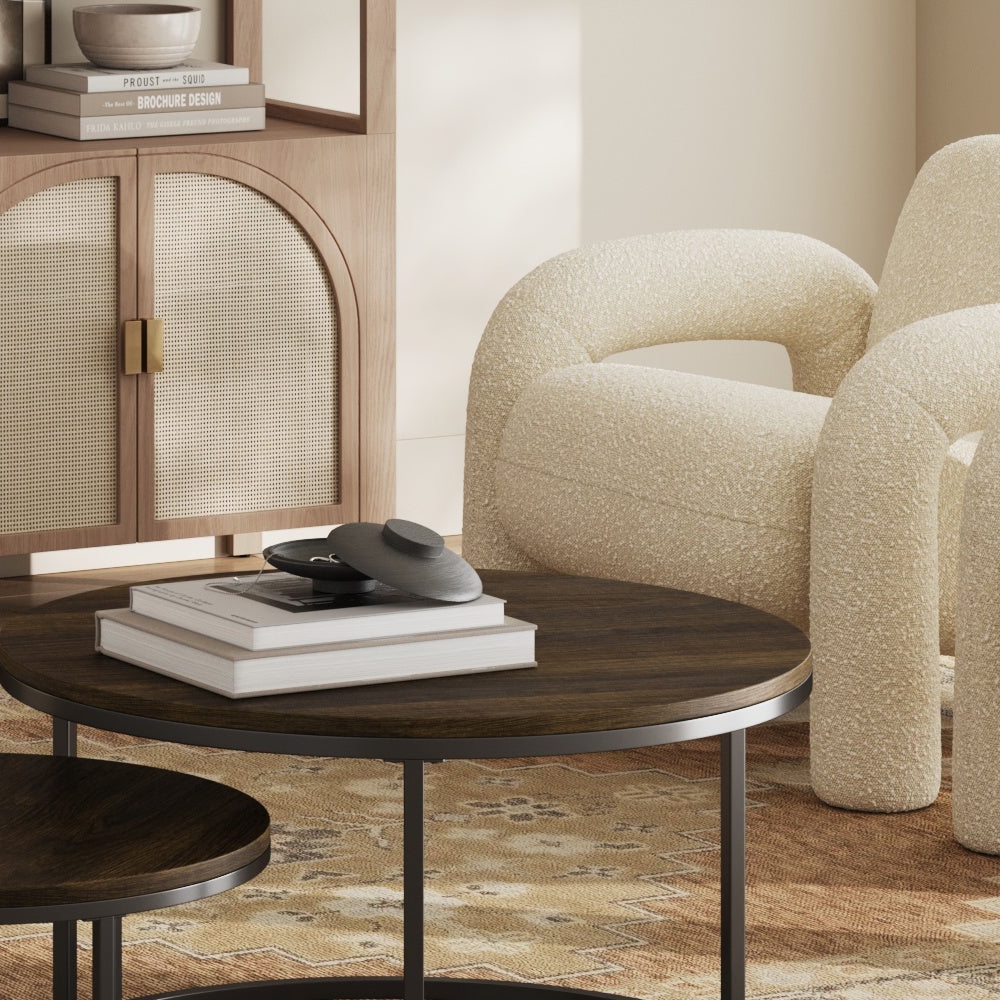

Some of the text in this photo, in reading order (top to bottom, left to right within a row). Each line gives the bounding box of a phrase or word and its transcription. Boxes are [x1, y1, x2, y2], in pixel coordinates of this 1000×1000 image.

[123, 76, 160, 88] PROUST
[182, 73, 206, 85] SQUID
[137, 93, 187, 110] BROCHURE
[188, 91, 222, 107] DESIGN
